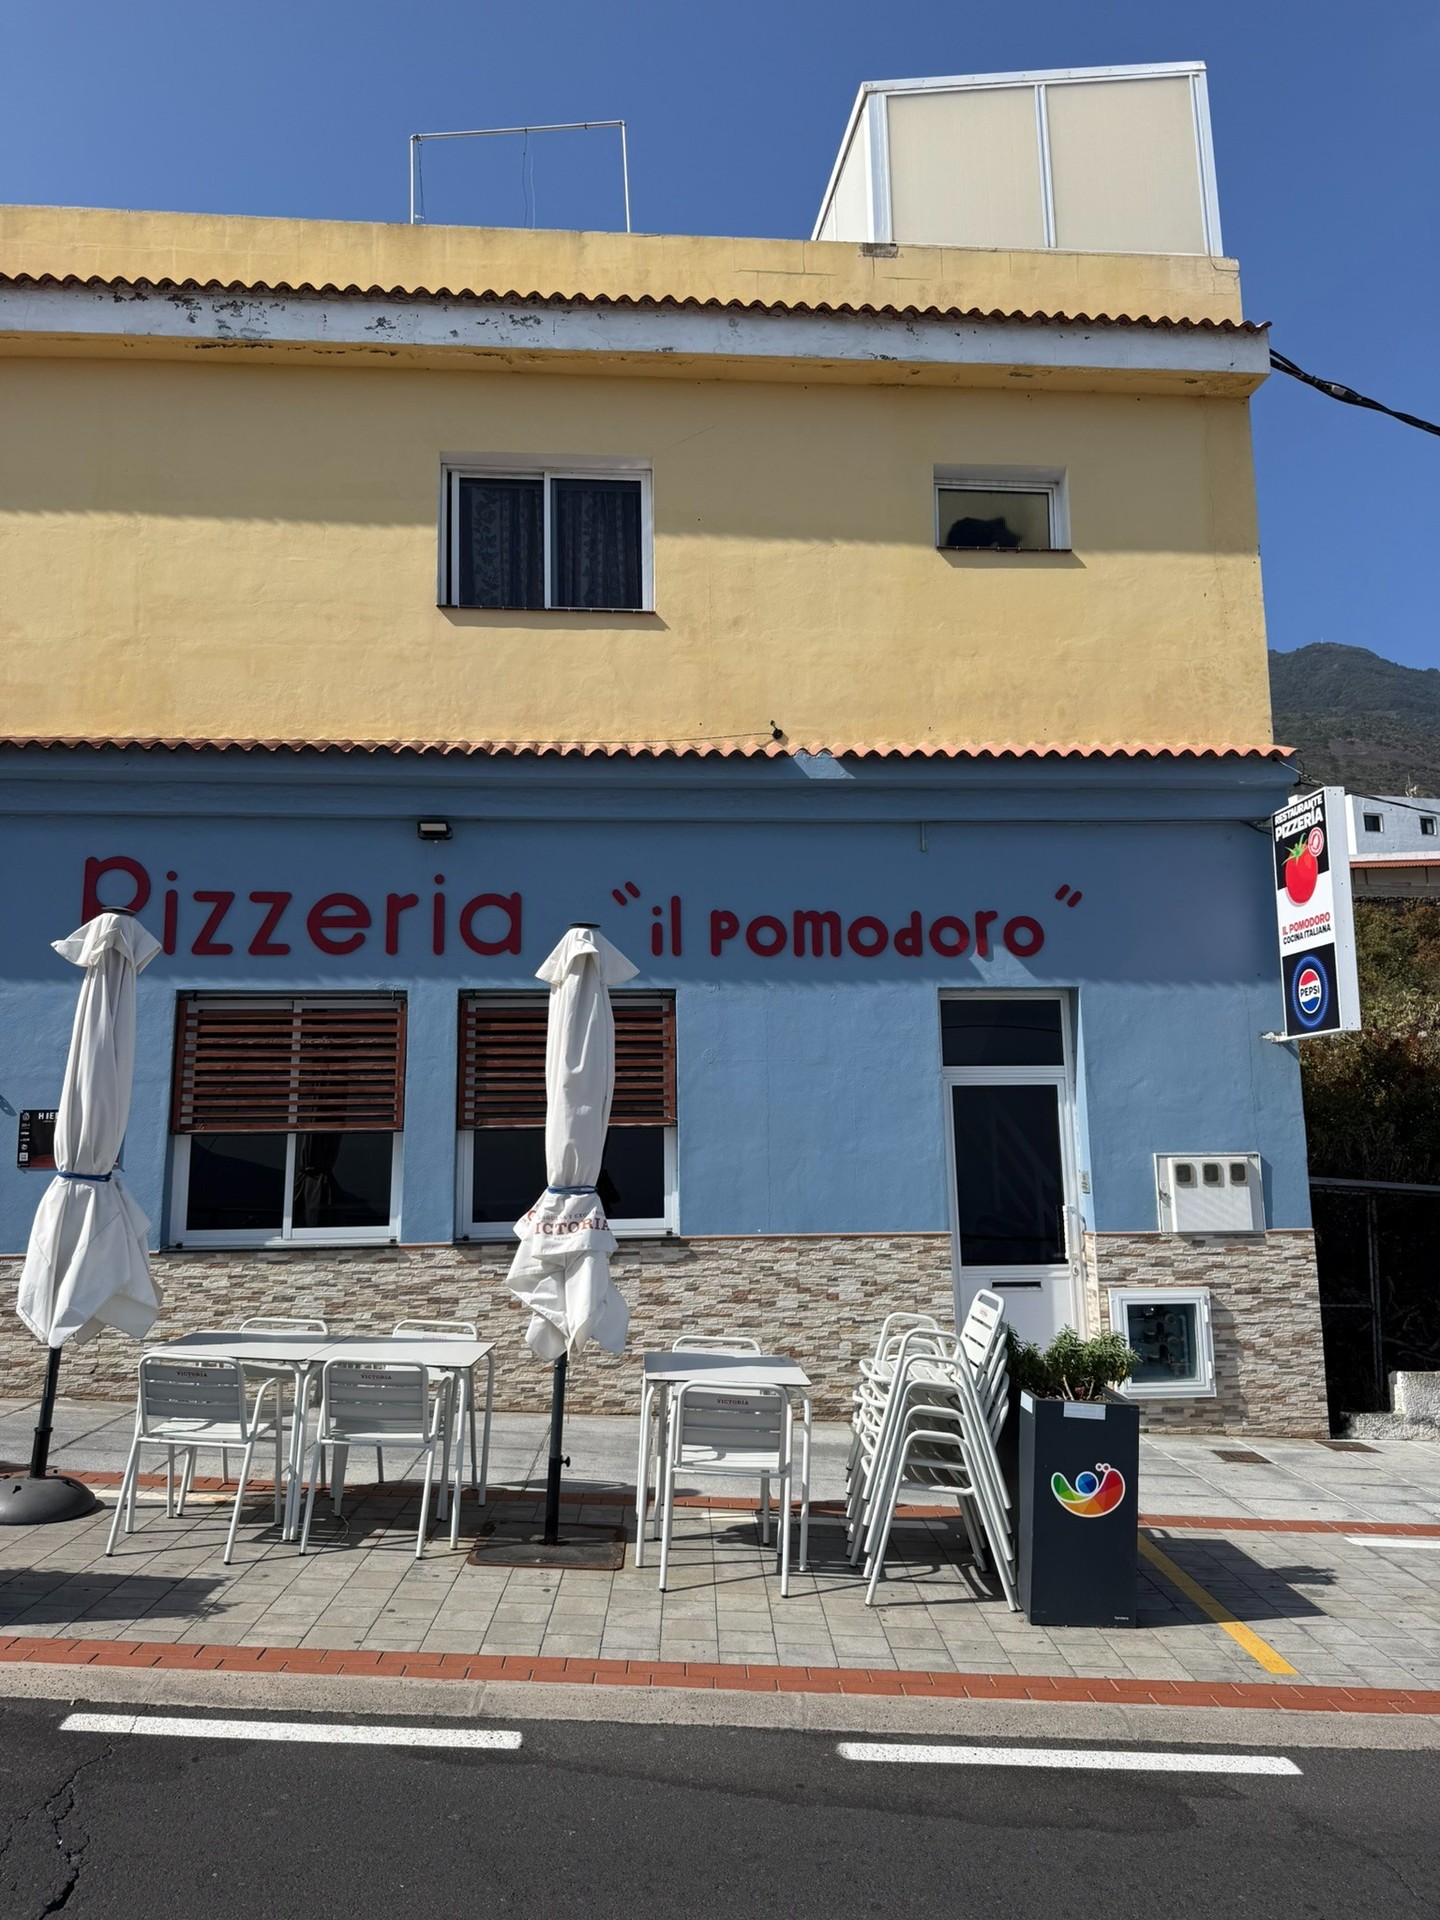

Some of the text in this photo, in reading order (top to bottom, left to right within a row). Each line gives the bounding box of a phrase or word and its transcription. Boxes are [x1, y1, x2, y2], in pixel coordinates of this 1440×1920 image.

[1274, 793, 1323, 825] RESTAURANTE
[82, 856, 522, 956] Pizzeria
[1282, 911, 1331, 936] IL POMODORO
[1283, 923, 1331, 945] COCINA ITALIANA
[1300, 985, 1320, 997] PEPSI
[535, 1216, 610, 1235] ICTORIA
[176, 1370, 208, 1378] VICTORIA
